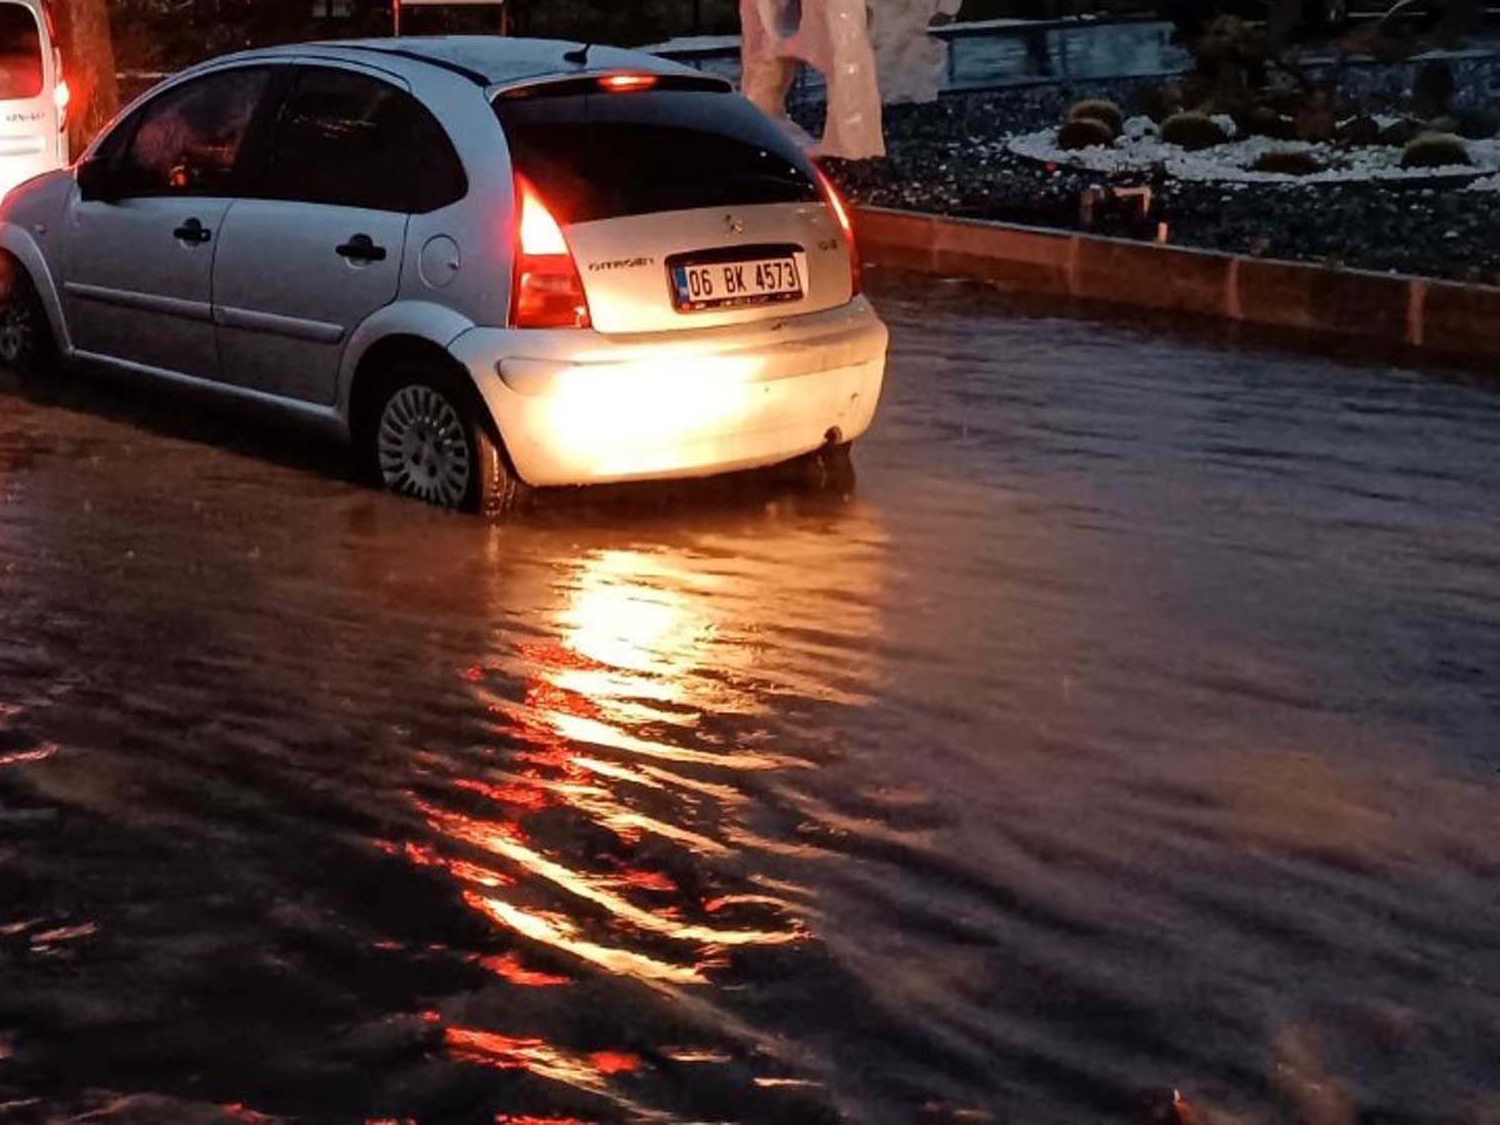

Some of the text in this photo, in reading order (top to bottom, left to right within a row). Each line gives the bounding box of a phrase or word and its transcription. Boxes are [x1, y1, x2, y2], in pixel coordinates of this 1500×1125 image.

[689, 262, 795, 297] 06 BK 4573
